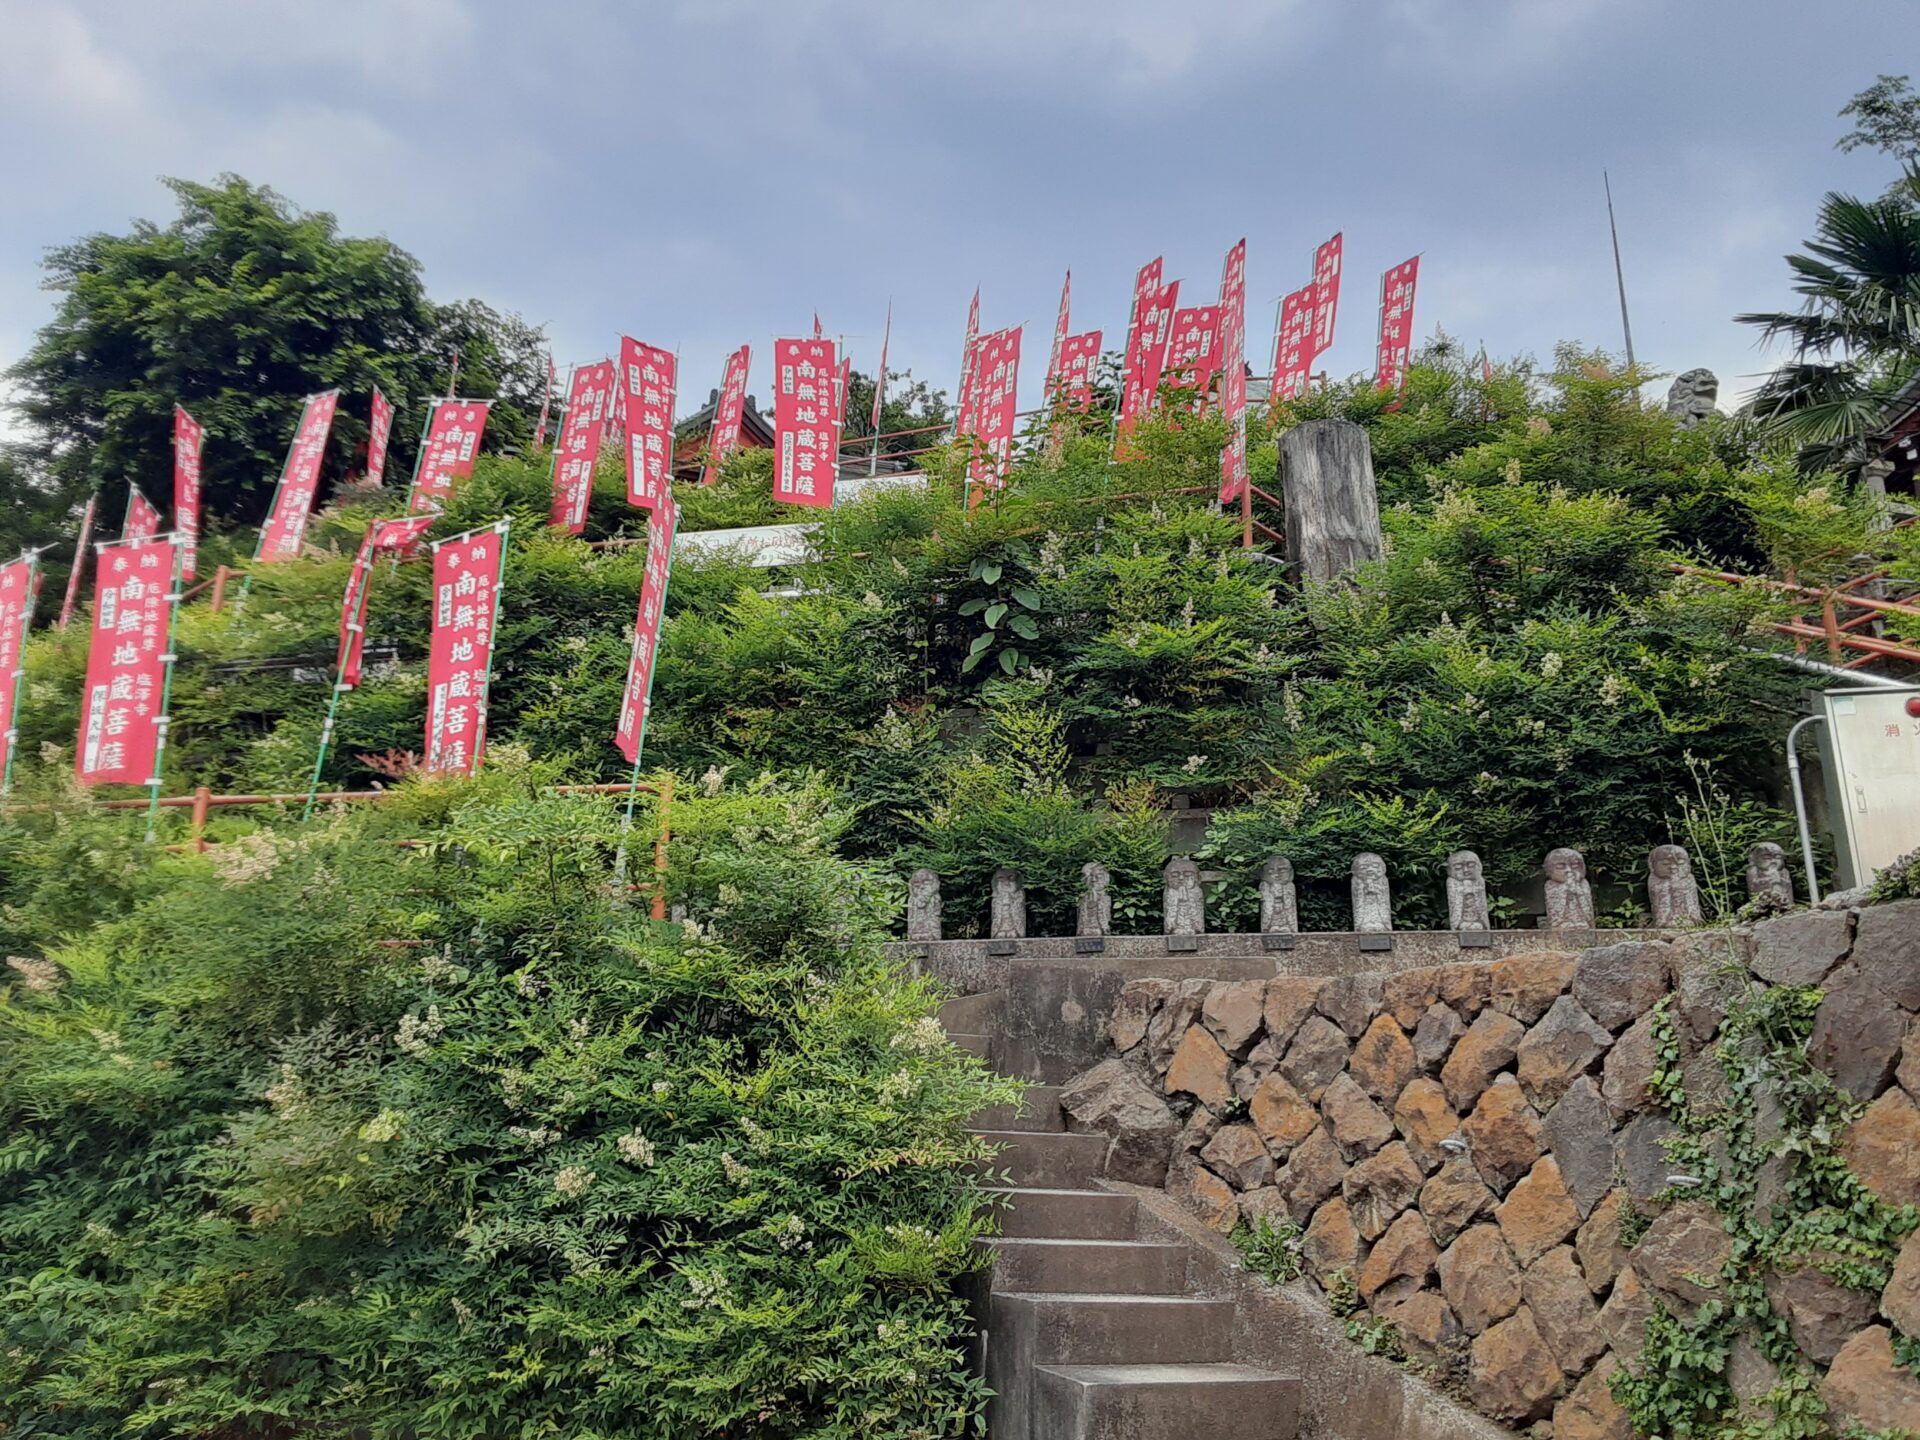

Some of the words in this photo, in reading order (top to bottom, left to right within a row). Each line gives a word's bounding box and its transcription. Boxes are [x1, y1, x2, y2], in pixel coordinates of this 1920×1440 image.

[788, 345, 824, 358] 奉納
[818, 367, 829, 418] 厄除地蔵尊
[794, 359, 819, 497] 南無地蔵菩薩
[112, 553, 159, 573] 奉納
[448, 545, 487, 569] 奉納
[475, 574, 491, 646] 厄除地蔵尊
[97, 575, 147, 771] 南無地蔵菩薩
[441, 570, 477, 770] 南無地蔵菩薩
